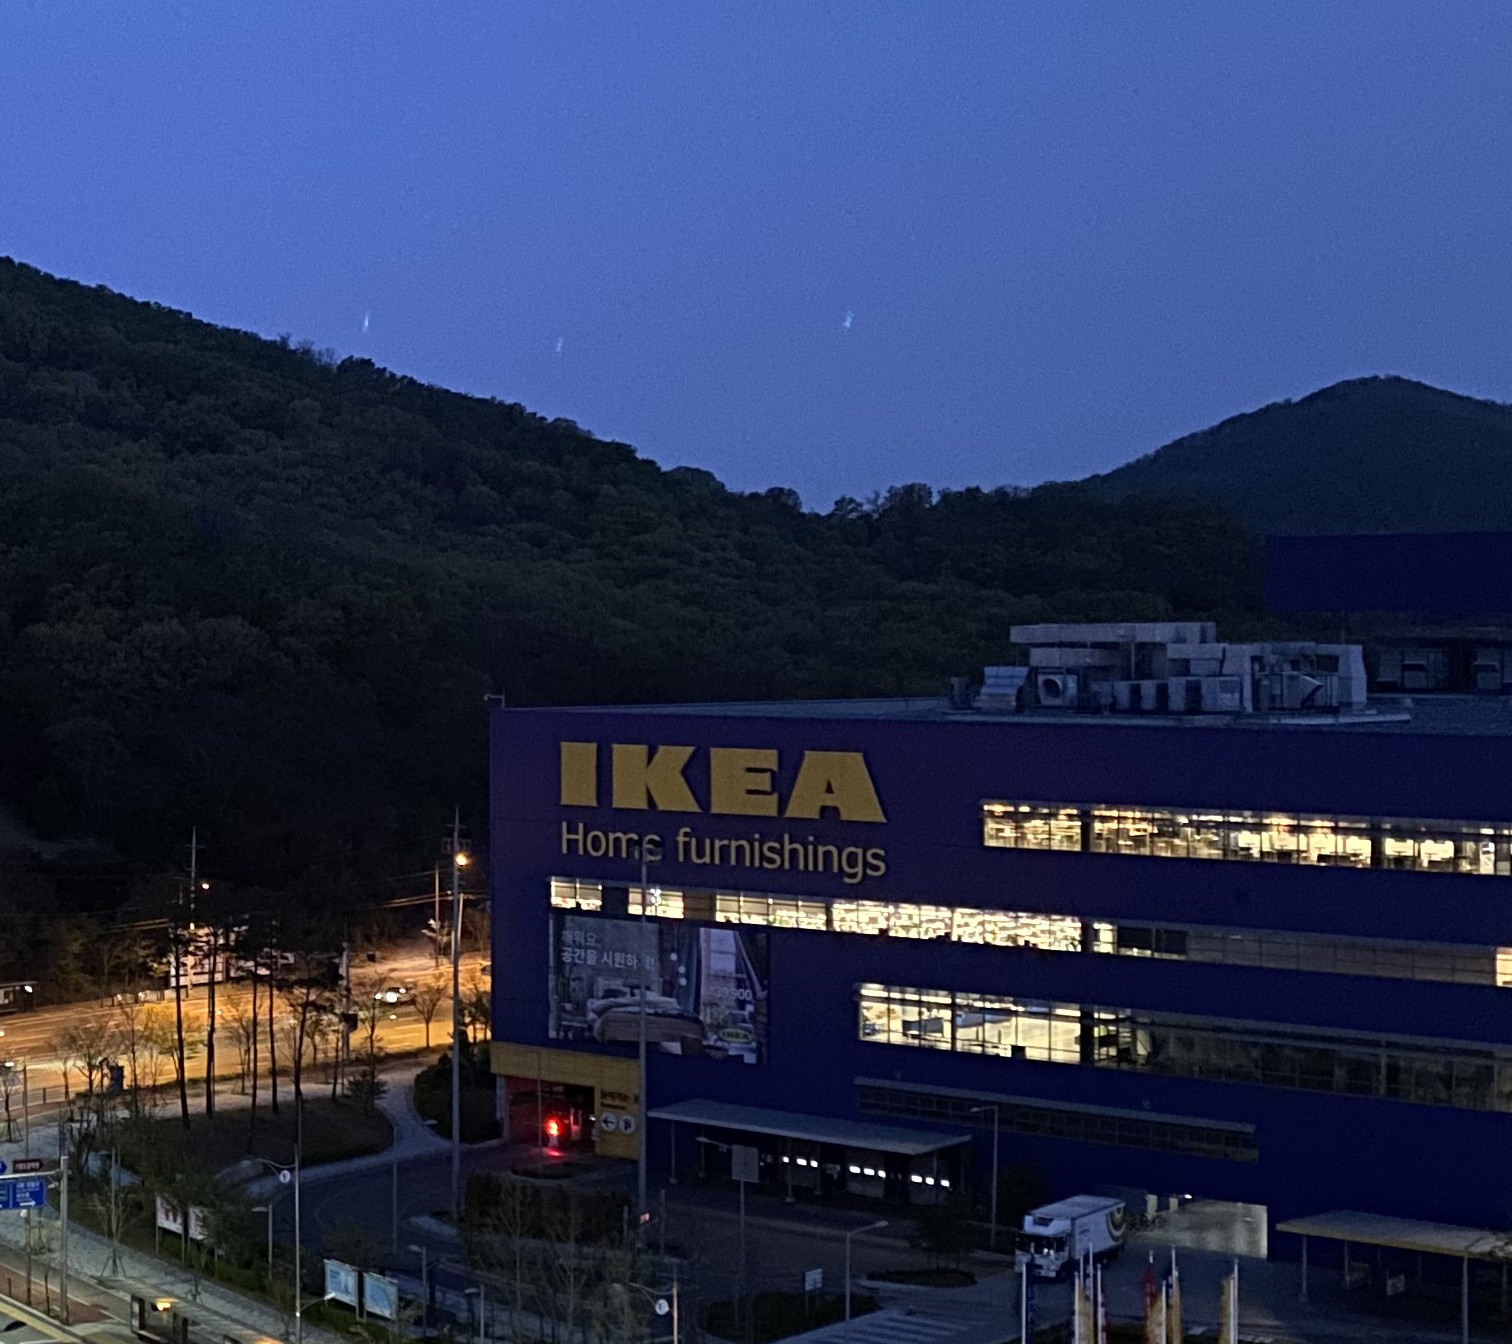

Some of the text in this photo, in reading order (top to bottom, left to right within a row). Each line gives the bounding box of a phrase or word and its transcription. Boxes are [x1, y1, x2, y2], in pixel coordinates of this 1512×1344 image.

[560, 741, 888, 823] IKEA
[561, 821, 887, 884] Home furnishings
